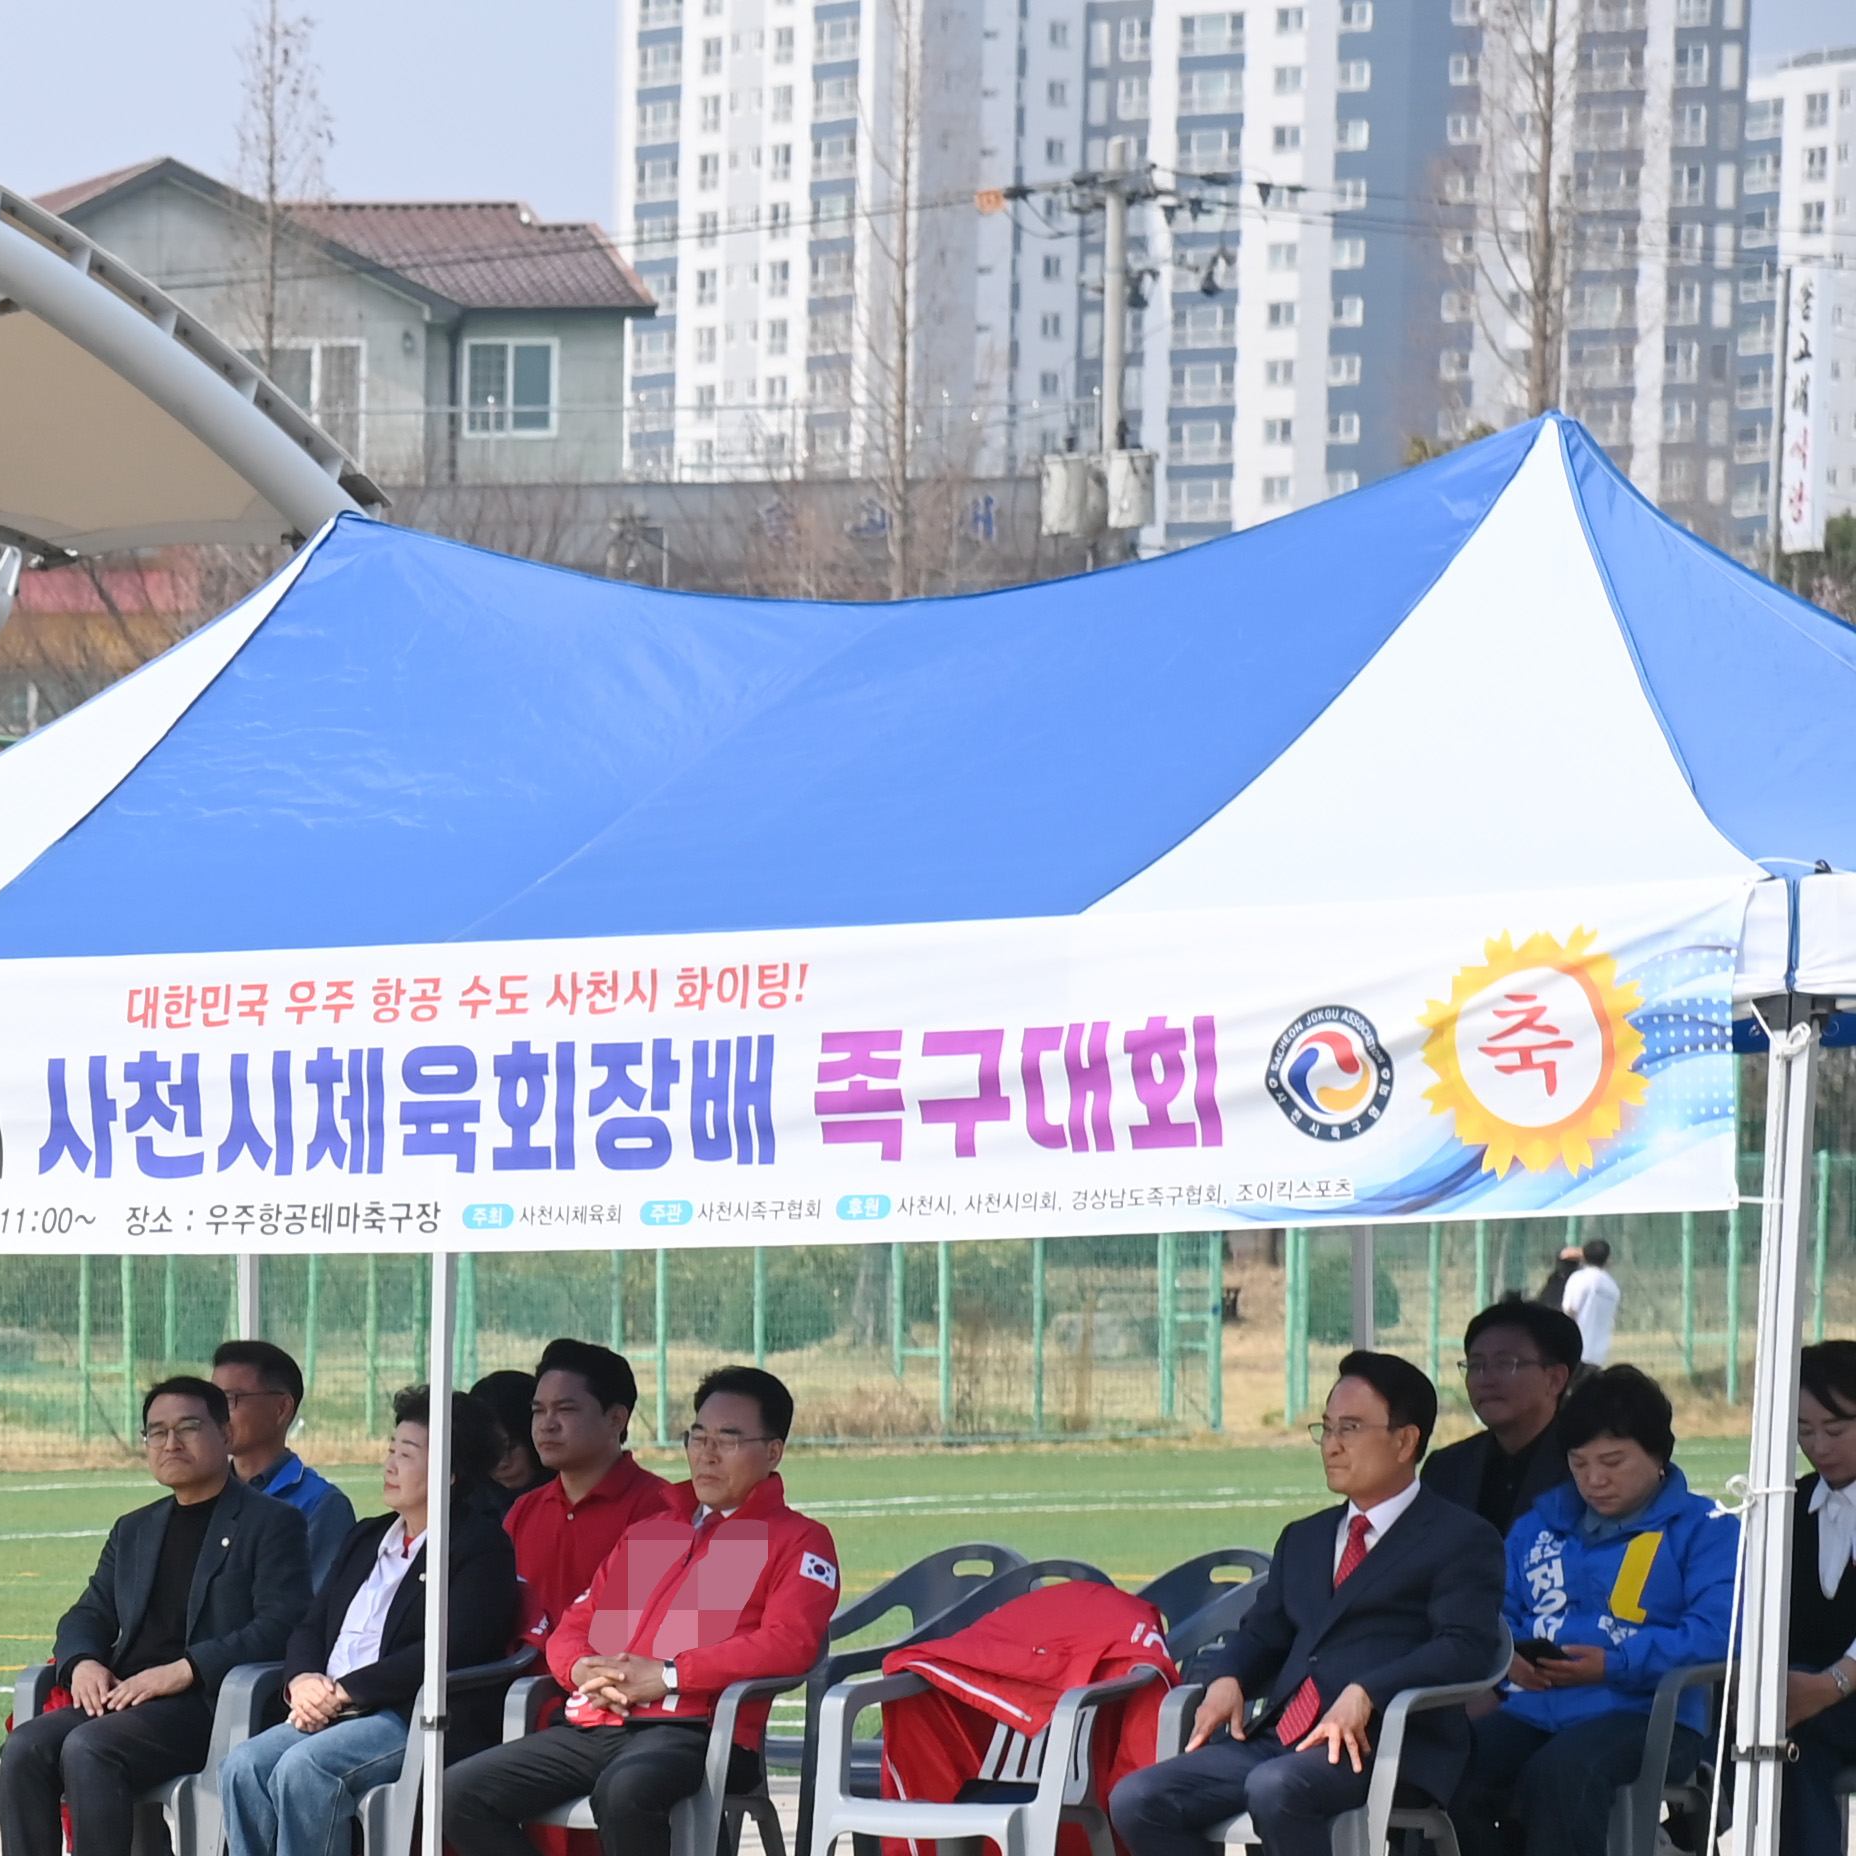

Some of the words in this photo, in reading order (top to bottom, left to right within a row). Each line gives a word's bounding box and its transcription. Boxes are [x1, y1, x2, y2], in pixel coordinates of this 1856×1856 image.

[126, 981, 269, 1030] 대한민국
[284, 979, 355, 1025] 우주
[371, 976, 444, 1023] 항공
[458, 973, 531, 1019] 수도
[545, 968, 662, 1016] 사천시
[674, 961, 810, 1011] 화이팅!
[1270, 1022, 1304, 1072] SACHEON
[1340, 1010, 1386, 1064] ASSOCIATION
[1477, 993, 1575, 1098] 축
[37, 1034, 777, 1181] 사천시체육회장배
[814, 1015, 1223, 1161] 족구대회
[0, 1206, 97, 1234] 11:00~
[126, 1205, 173, 1236] 장소
[206, 1200, 442, 1236] 우주항공테마축구장
[471, 1206, 503, 1227] 주최
[519, 1203, 622, 1226] 사천시체육회
[649, 1203, 683, 1223] 주관
[697, 1198, 822, 1222] 사천시족구협회
[846, 1197, 880, 1218] 후원
[896, 1193, 958, 1217] 사천시,
[964, 1191, 1062, 1215] 사천시의회,
[1071, 1183, 1228, 1212] 경상남도족구협회,
[1235, 1177, 1354, 1203] 조이킥스포츠
